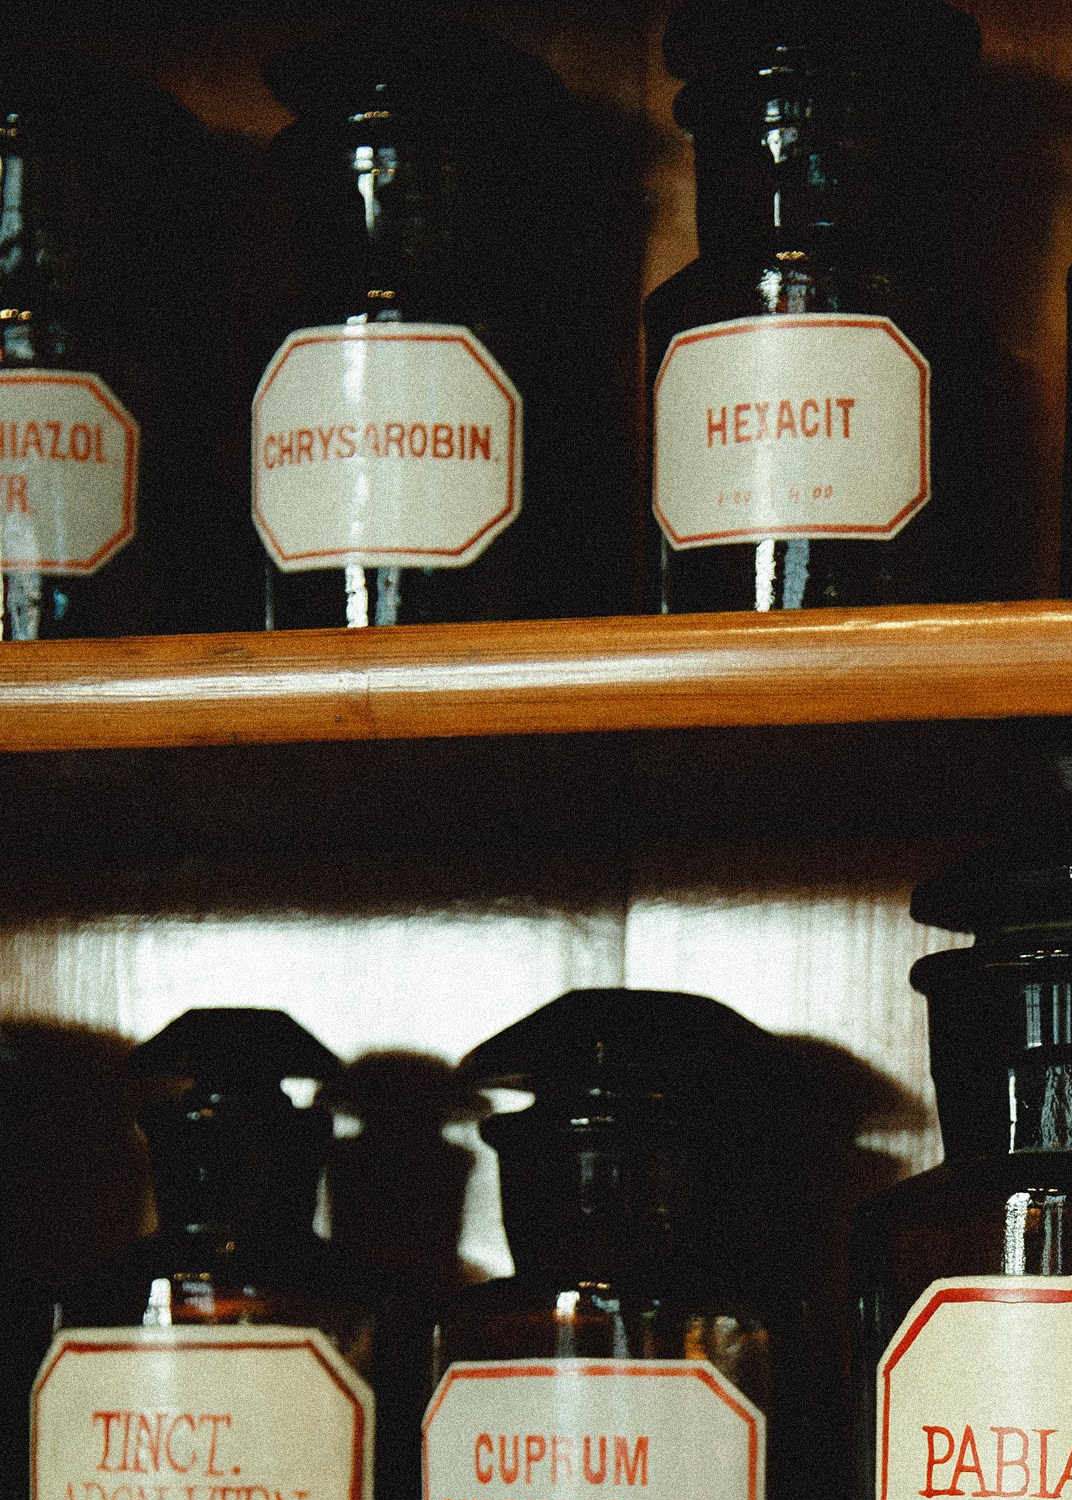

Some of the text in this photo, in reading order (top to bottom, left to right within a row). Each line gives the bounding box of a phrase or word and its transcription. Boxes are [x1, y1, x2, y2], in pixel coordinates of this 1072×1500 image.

[706, 397, 856, 448] HEXACIT
[91, 1409, 242, 1477] TINCT.
[474, 1432, 650, 1487] CUPRUM
